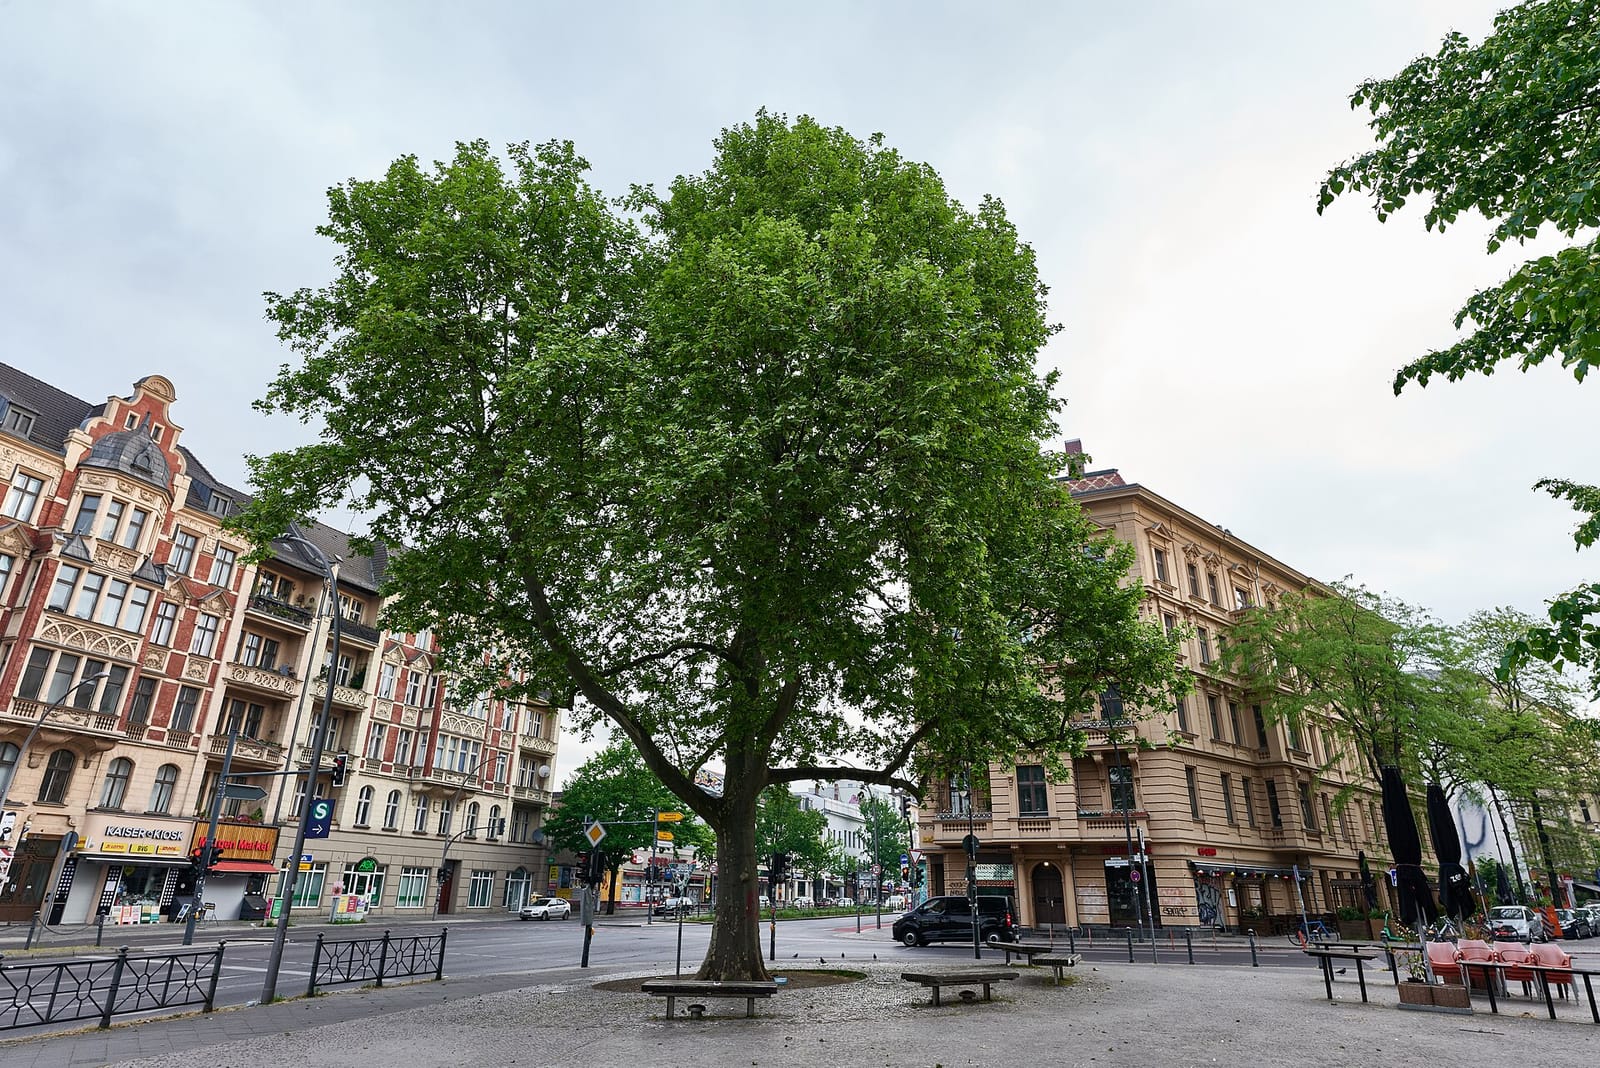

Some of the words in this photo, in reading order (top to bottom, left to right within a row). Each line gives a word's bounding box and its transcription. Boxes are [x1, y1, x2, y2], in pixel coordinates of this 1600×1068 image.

[314, 803, 328, 819] S
[105, 826, 146, 838] KAISER
[152, 828, 183, 841] KIOSK
[238, 839, 271, 852] Market
